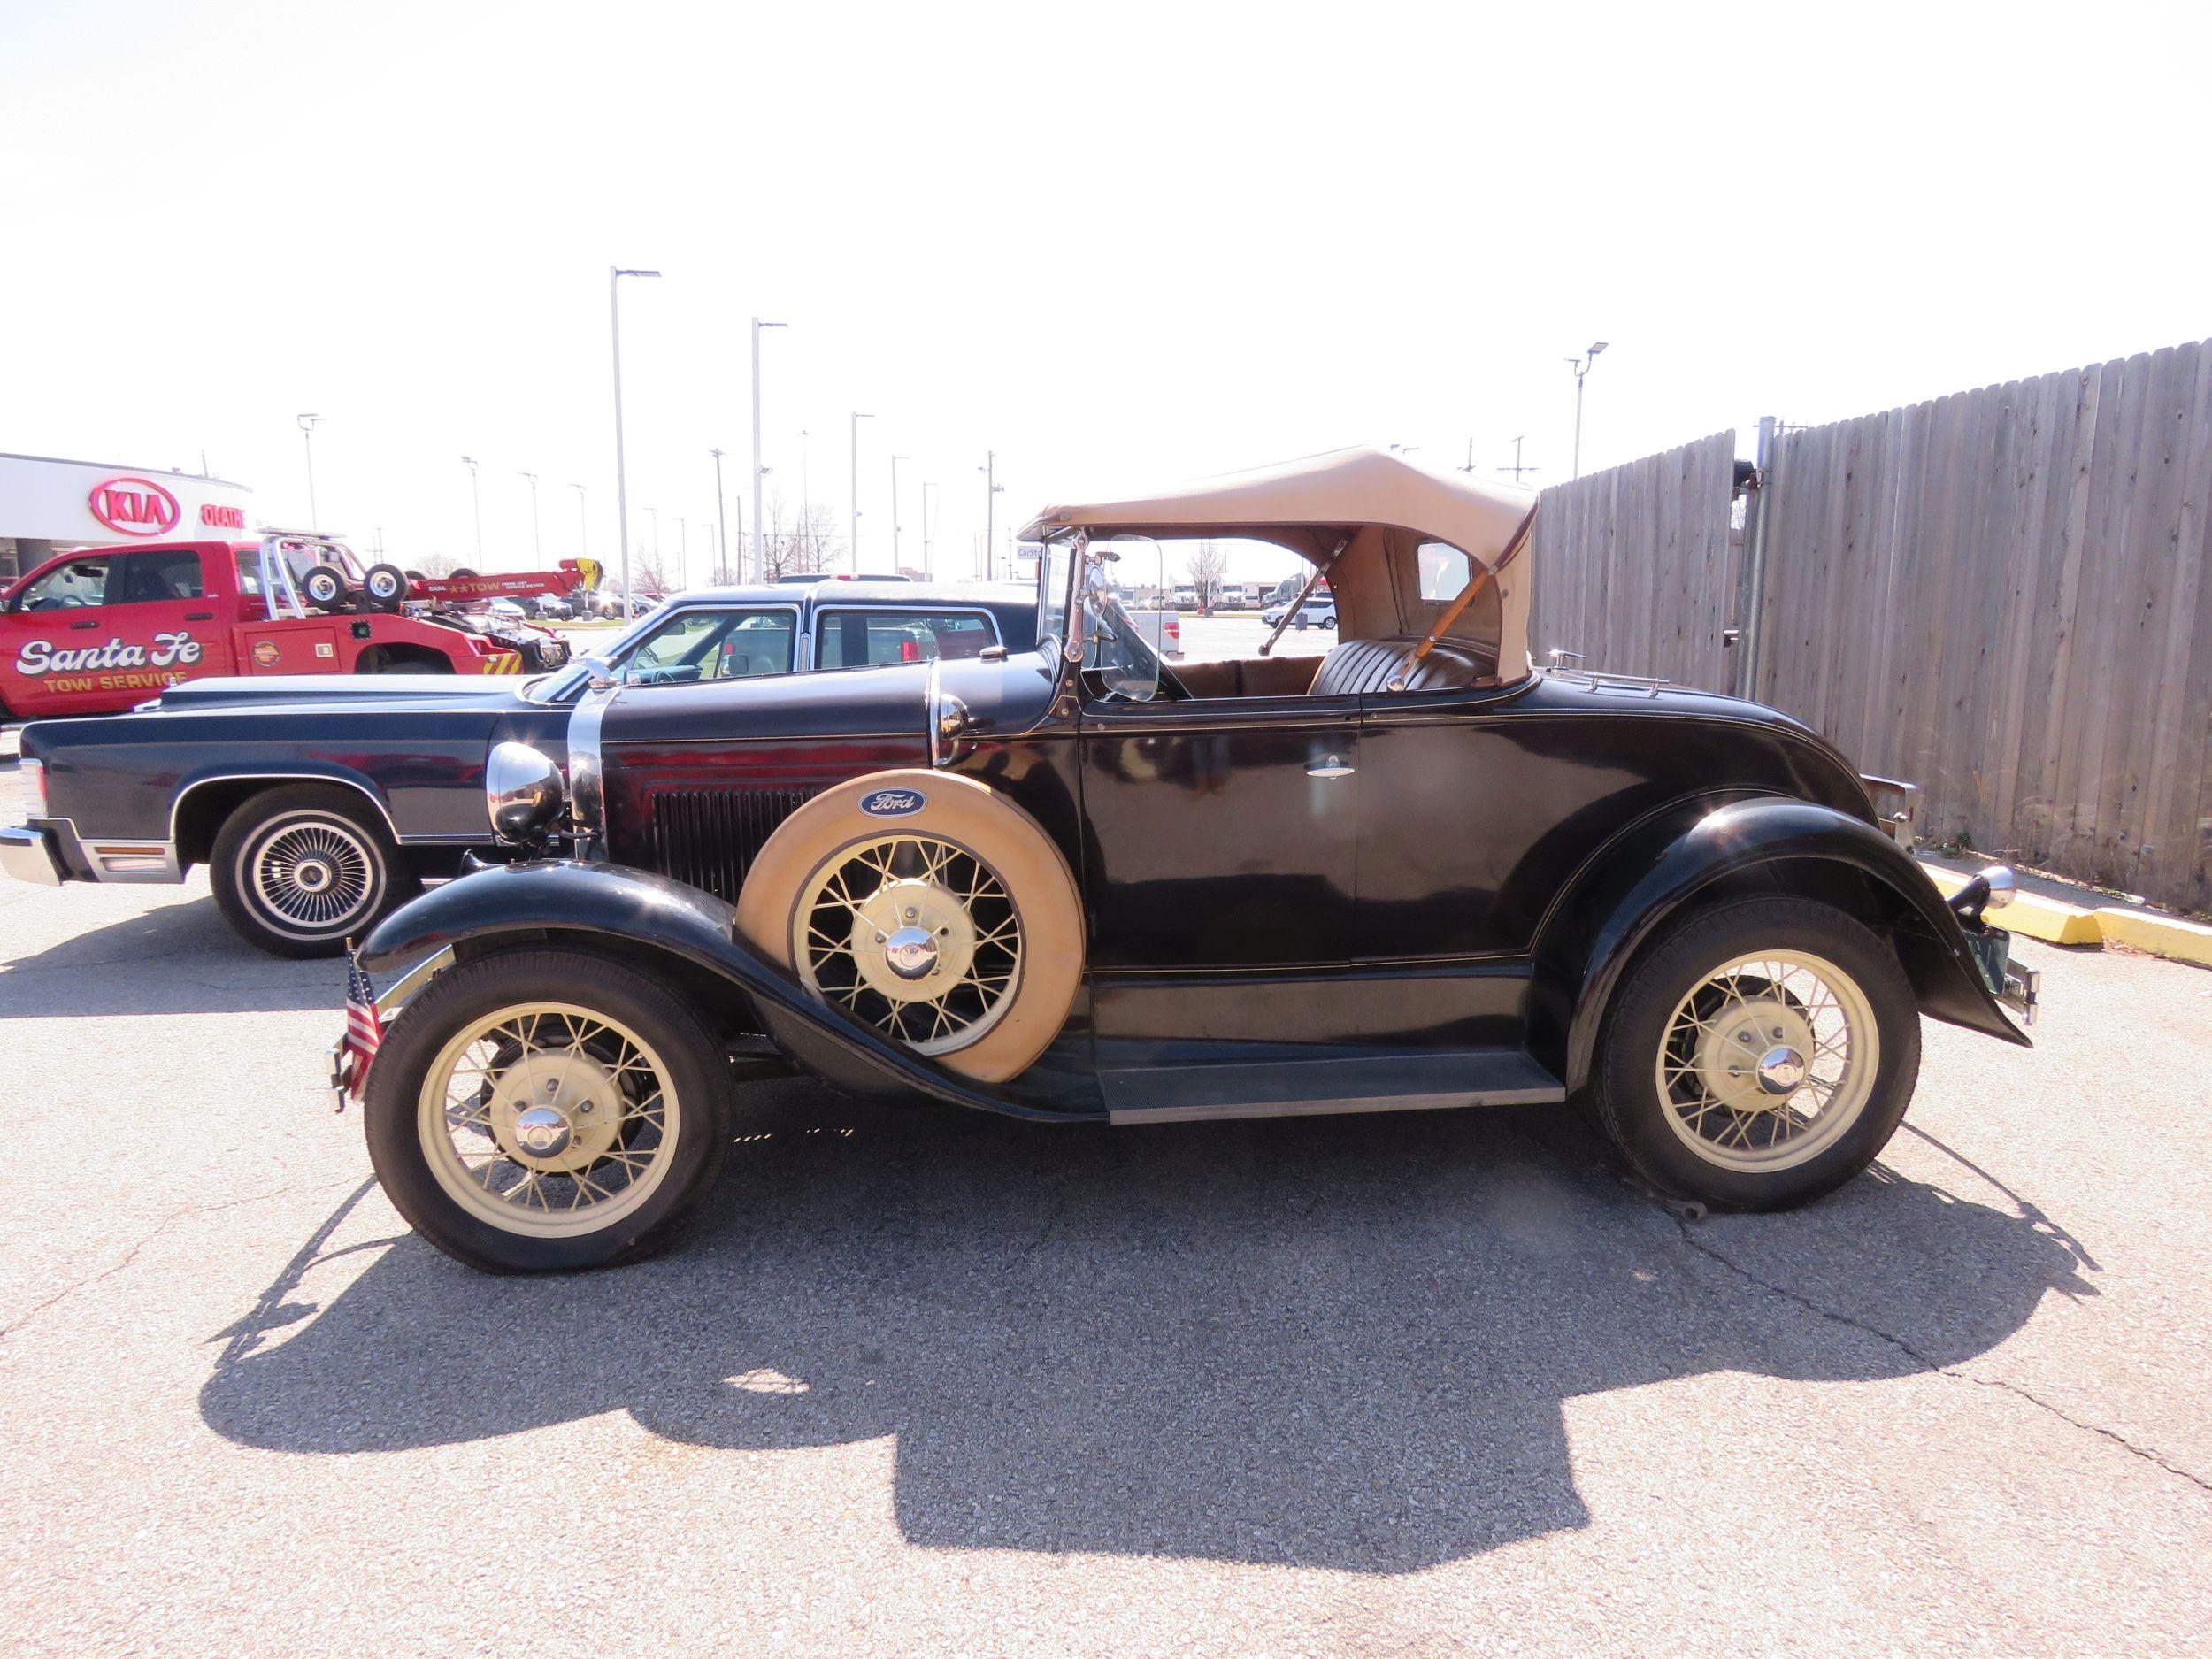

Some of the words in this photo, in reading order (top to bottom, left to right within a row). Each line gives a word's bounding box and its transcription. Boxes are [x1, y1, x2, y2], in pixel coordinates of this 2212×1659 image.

[104, 489, 170, 526] KIA
[16, 637, 145, 675] Santa
[151, 631, 201, 666] Fe
[44, 677, 92, 694] TOW
[99, 672, 187, 690] SERVICE
[870, 793, 915, 811] Ford
